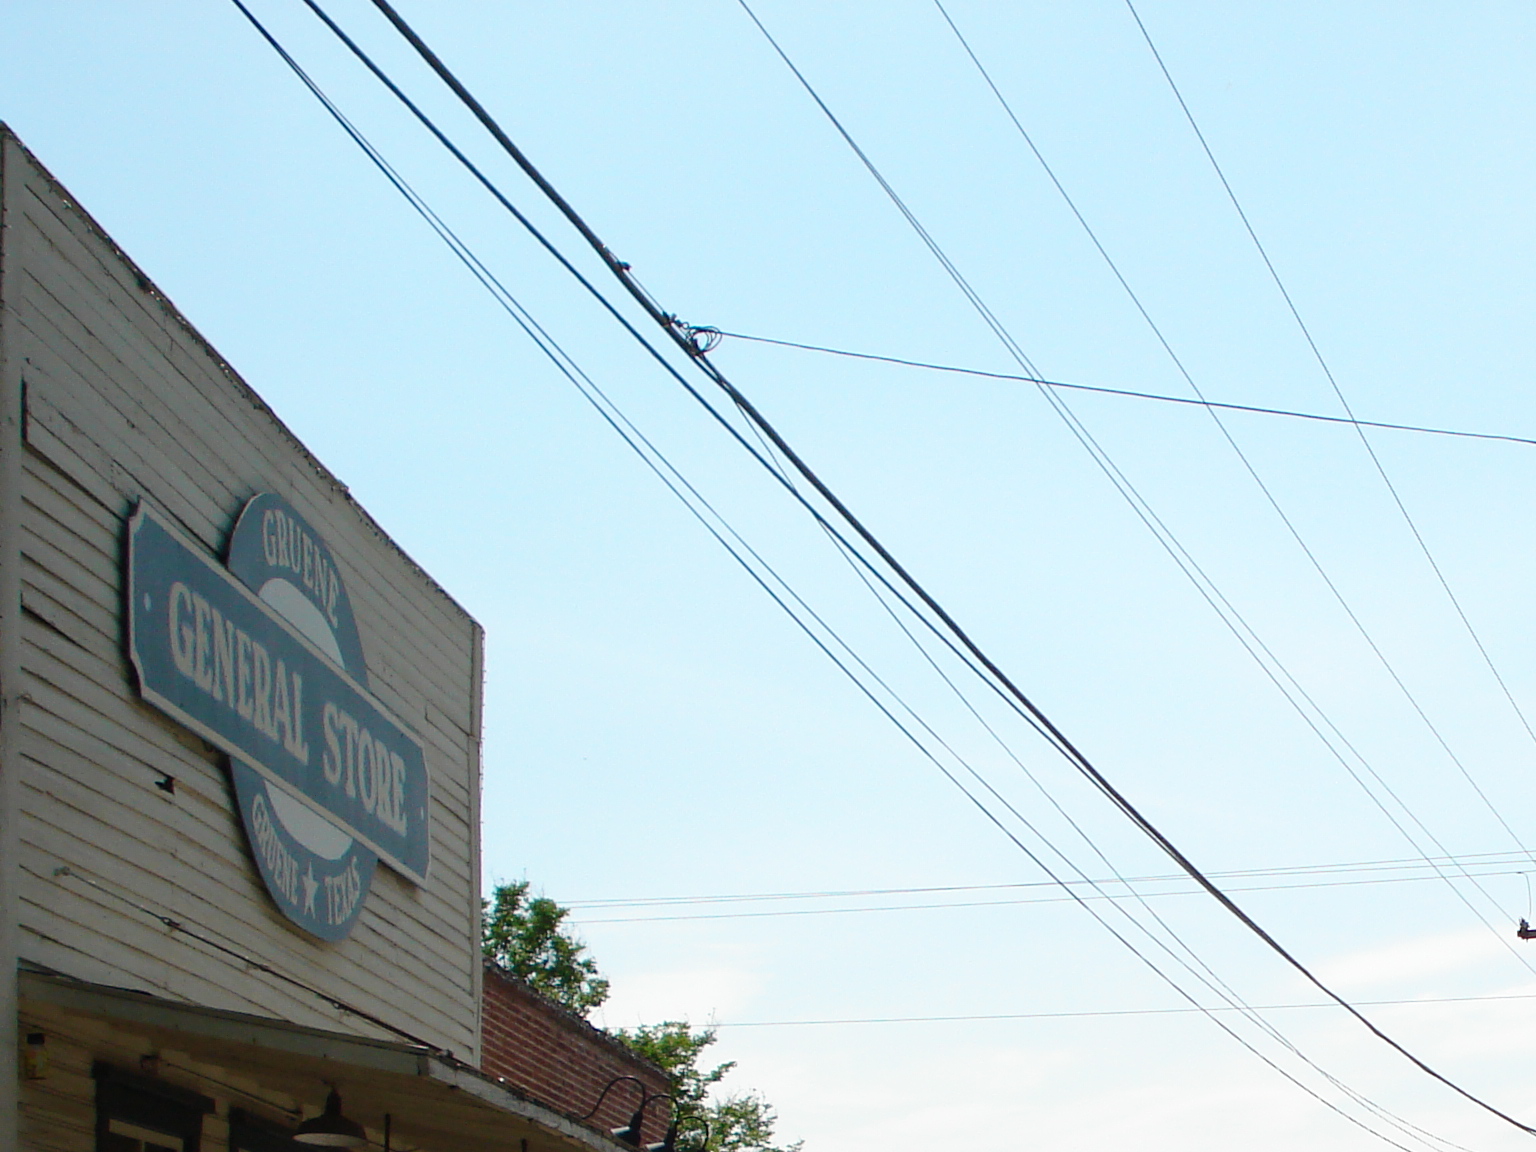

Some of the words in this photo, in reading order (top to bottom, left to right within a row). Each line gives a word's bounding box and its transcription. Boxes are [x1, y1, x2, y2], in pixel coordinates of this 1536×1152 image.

[263, 509, 340, 629] GRUENE
[168, 581, 310, 766] GENERAL
[322, 702, 408, 838] STORE
[252, 793, 299, 906] GRUENE
[324, 856, 361, 925] TEXAS
